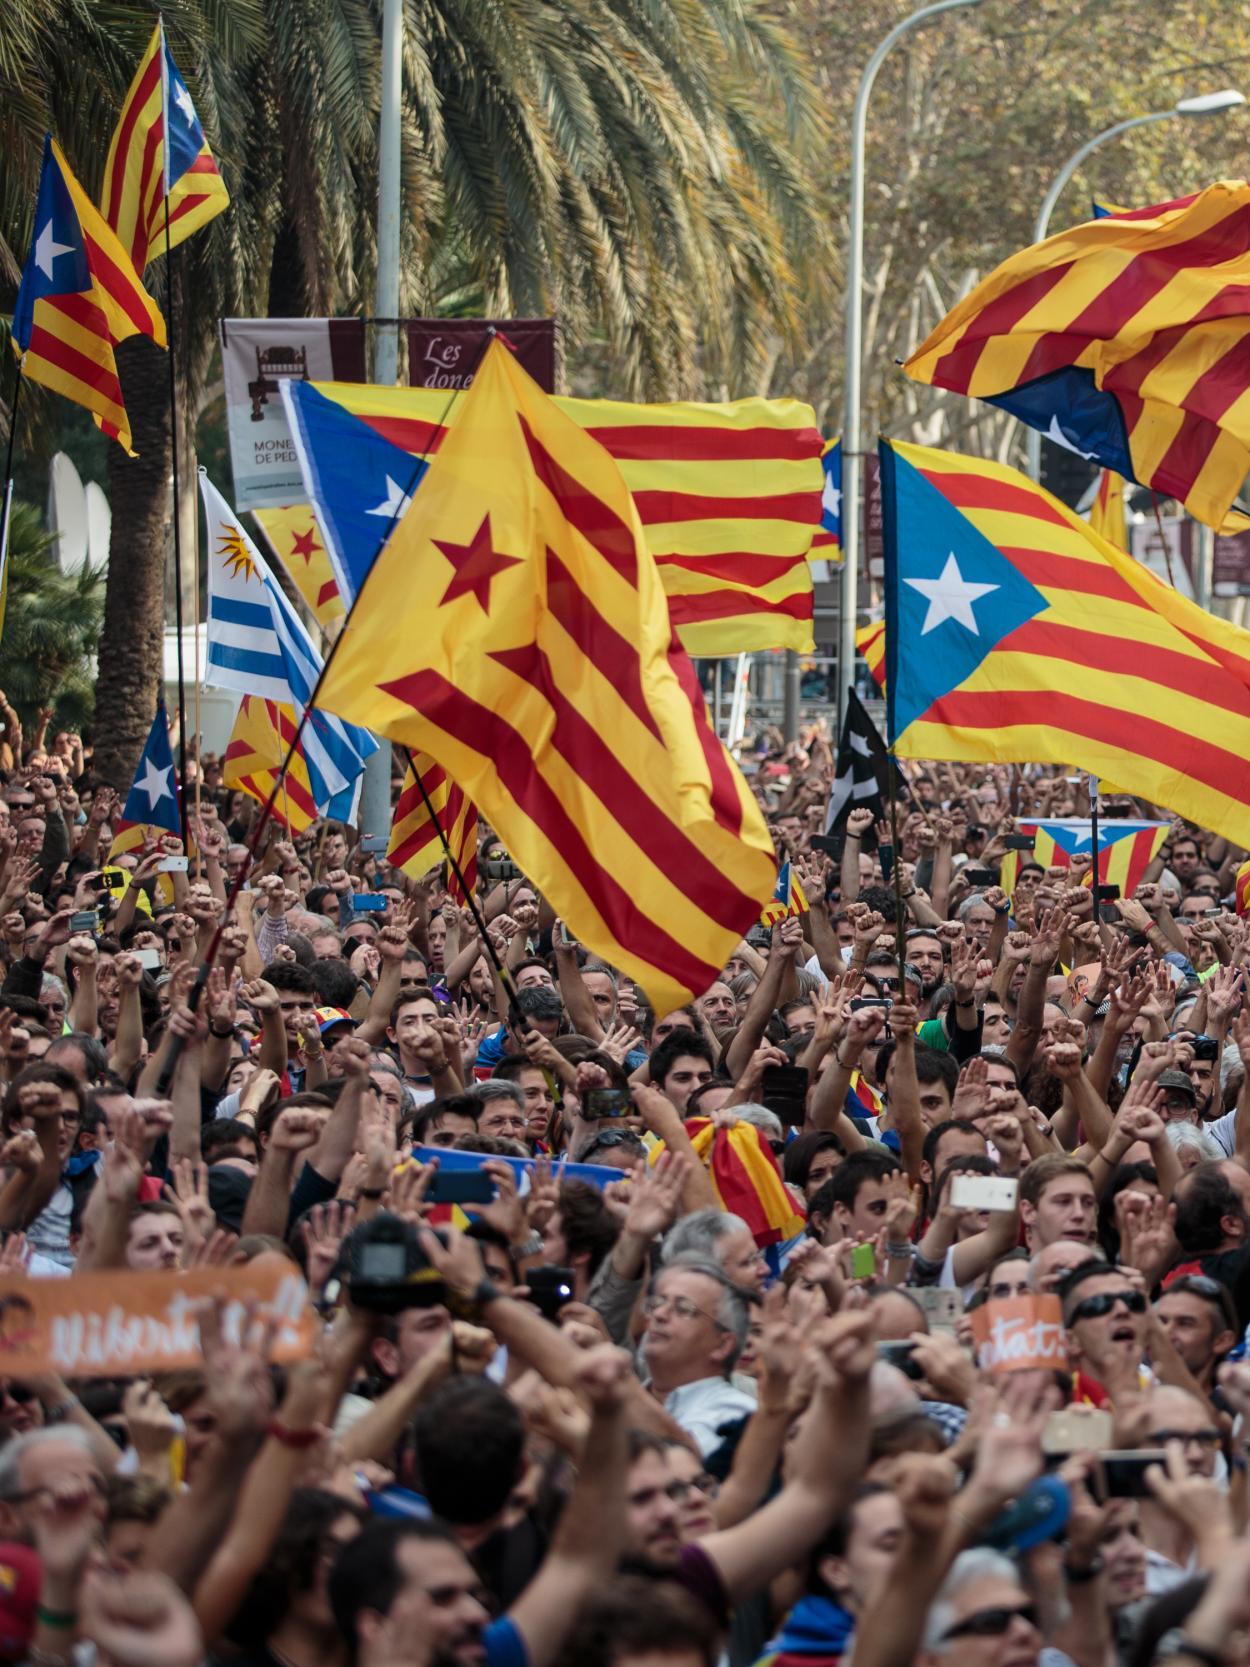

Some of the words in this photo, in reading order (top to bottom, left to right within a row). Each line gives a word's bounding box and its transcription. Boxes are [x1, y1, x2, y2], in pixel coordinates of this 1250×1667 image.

[424, 337, 462, 369] Les
[424, 367, 474, 389] done
[254, 439, 295, 451] MONE
[255, 453, 272, 465] DE
[274, 450, 298, 463] PED
